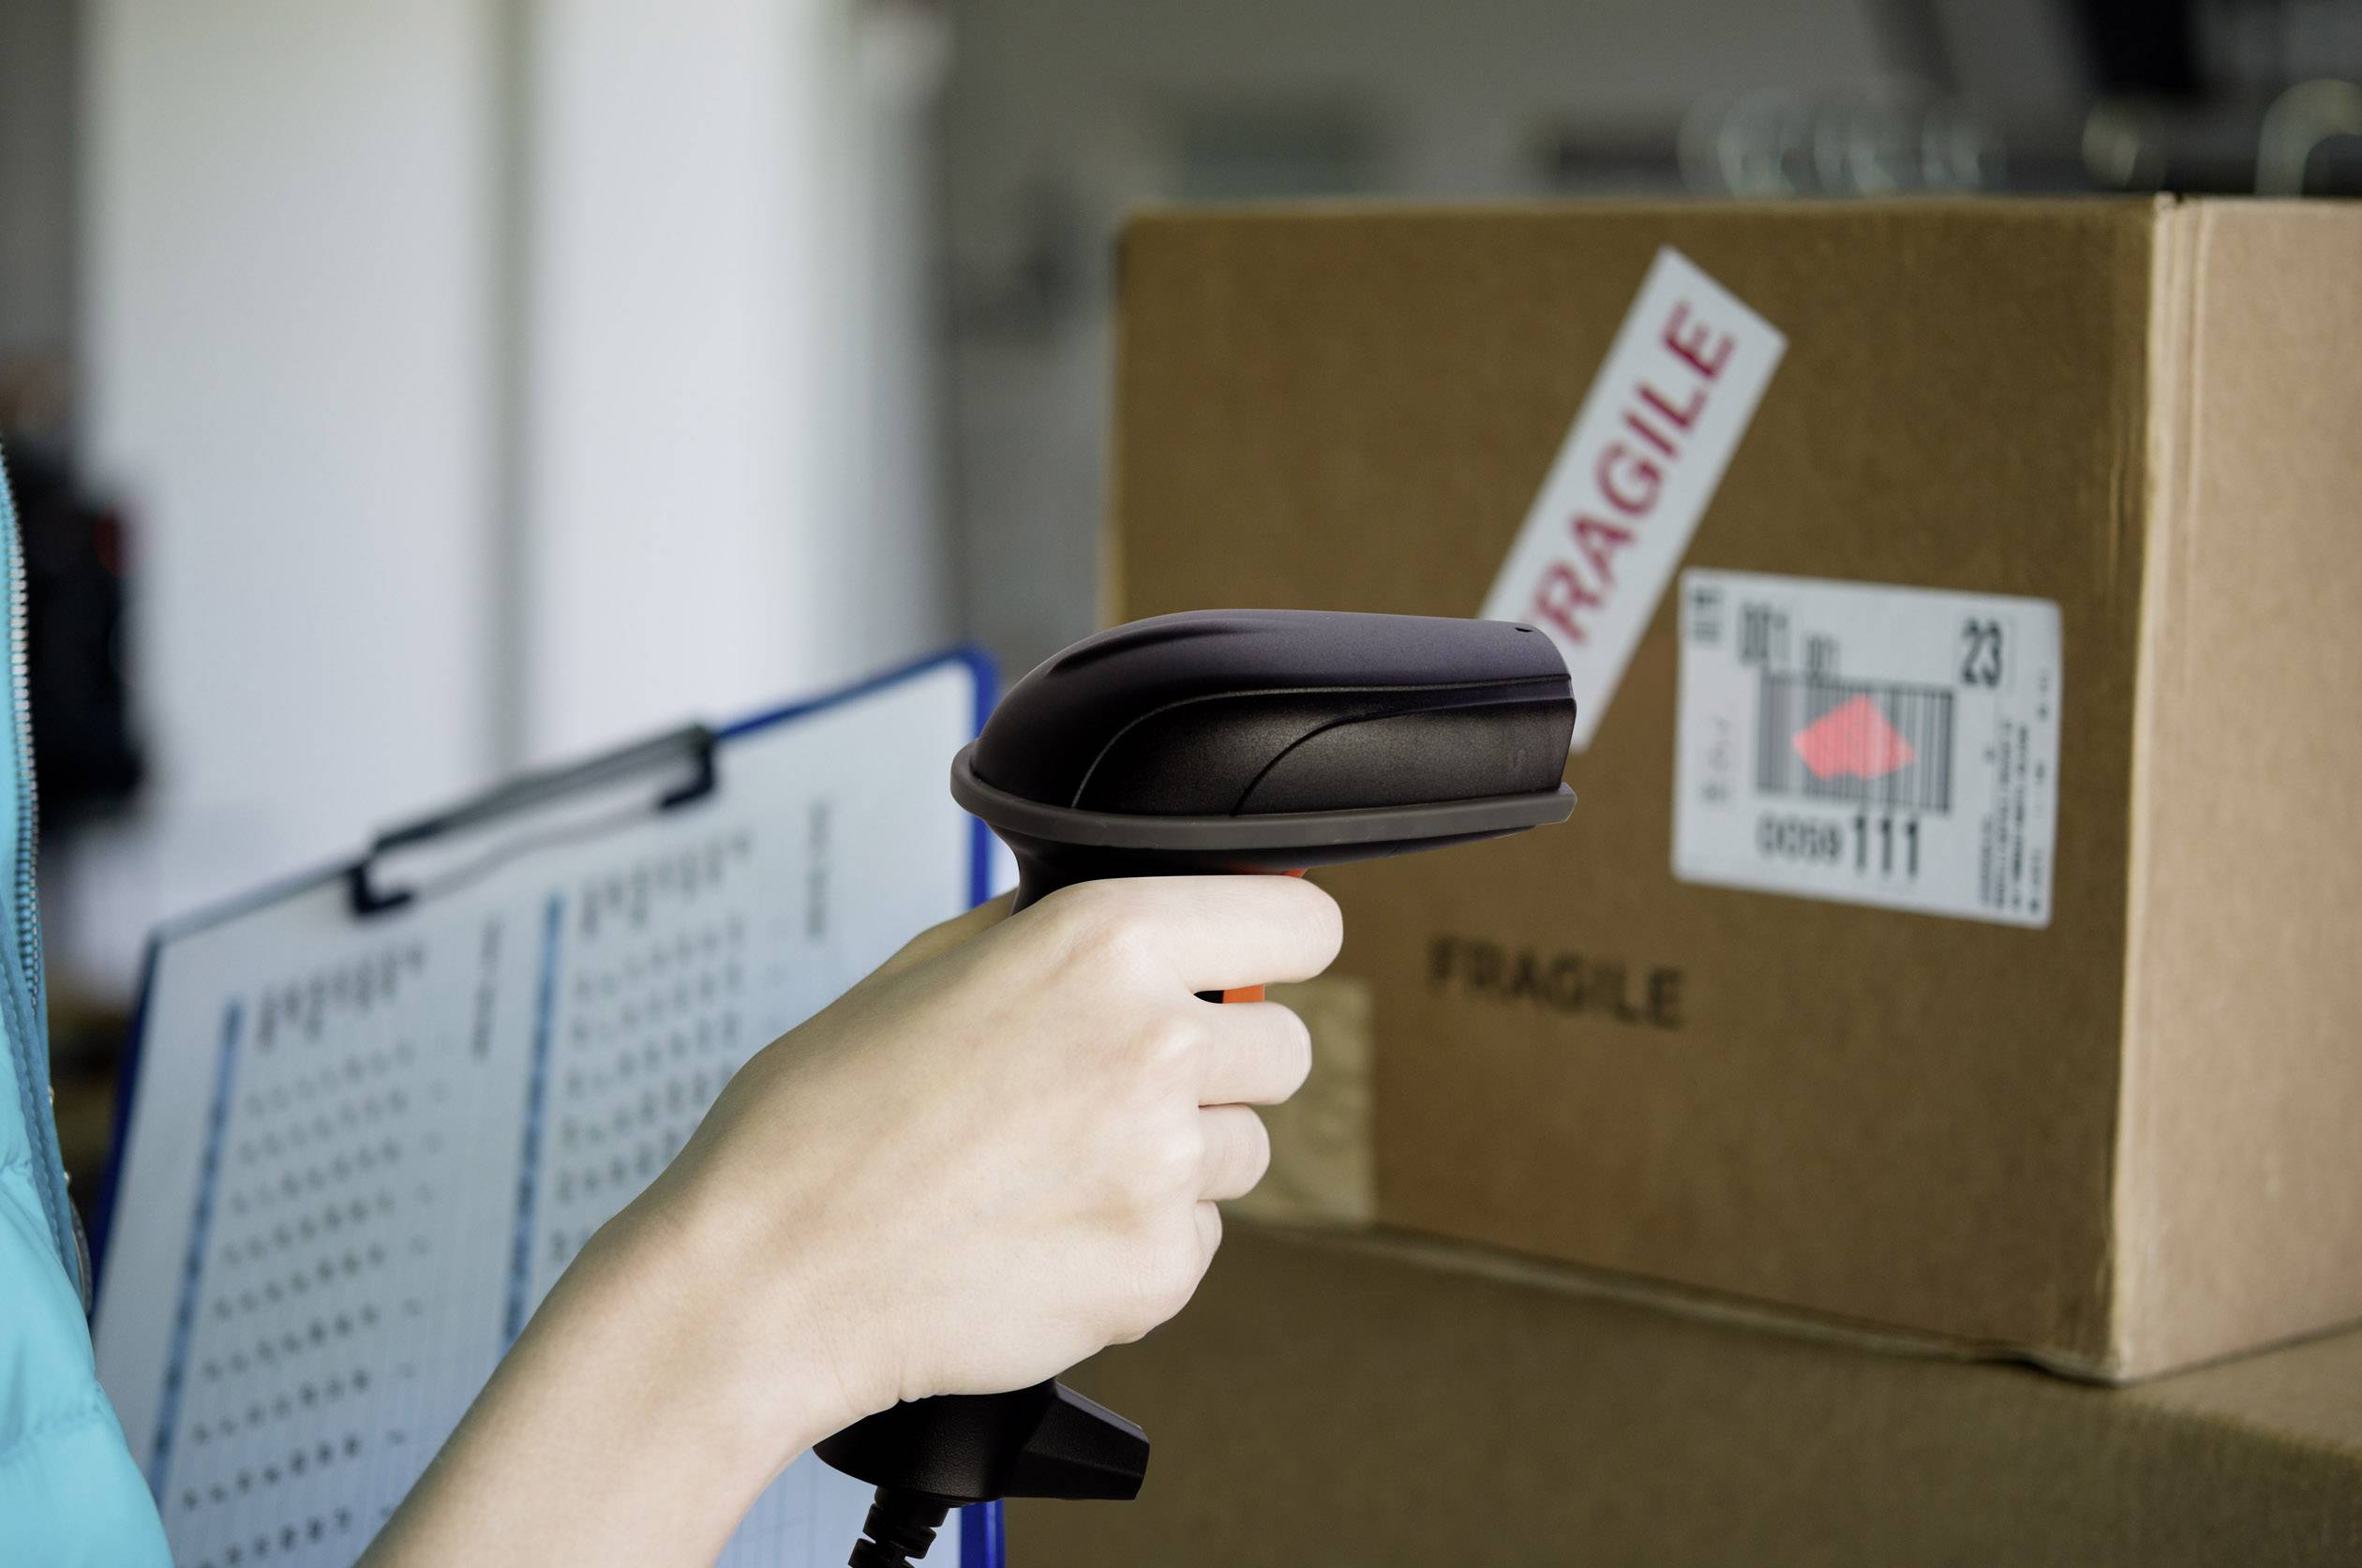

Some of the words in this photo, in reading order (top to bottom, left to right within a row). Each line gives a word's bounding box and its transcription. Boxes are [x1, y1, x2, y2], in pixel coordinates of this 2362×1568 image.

[1522, 300, 1737, 647] RAGILE
[1961, 617, 2005, 689] 23
[1853, 812, 1921, 878] 111
[1427, 934, 1681, 1030] FRAGILE
